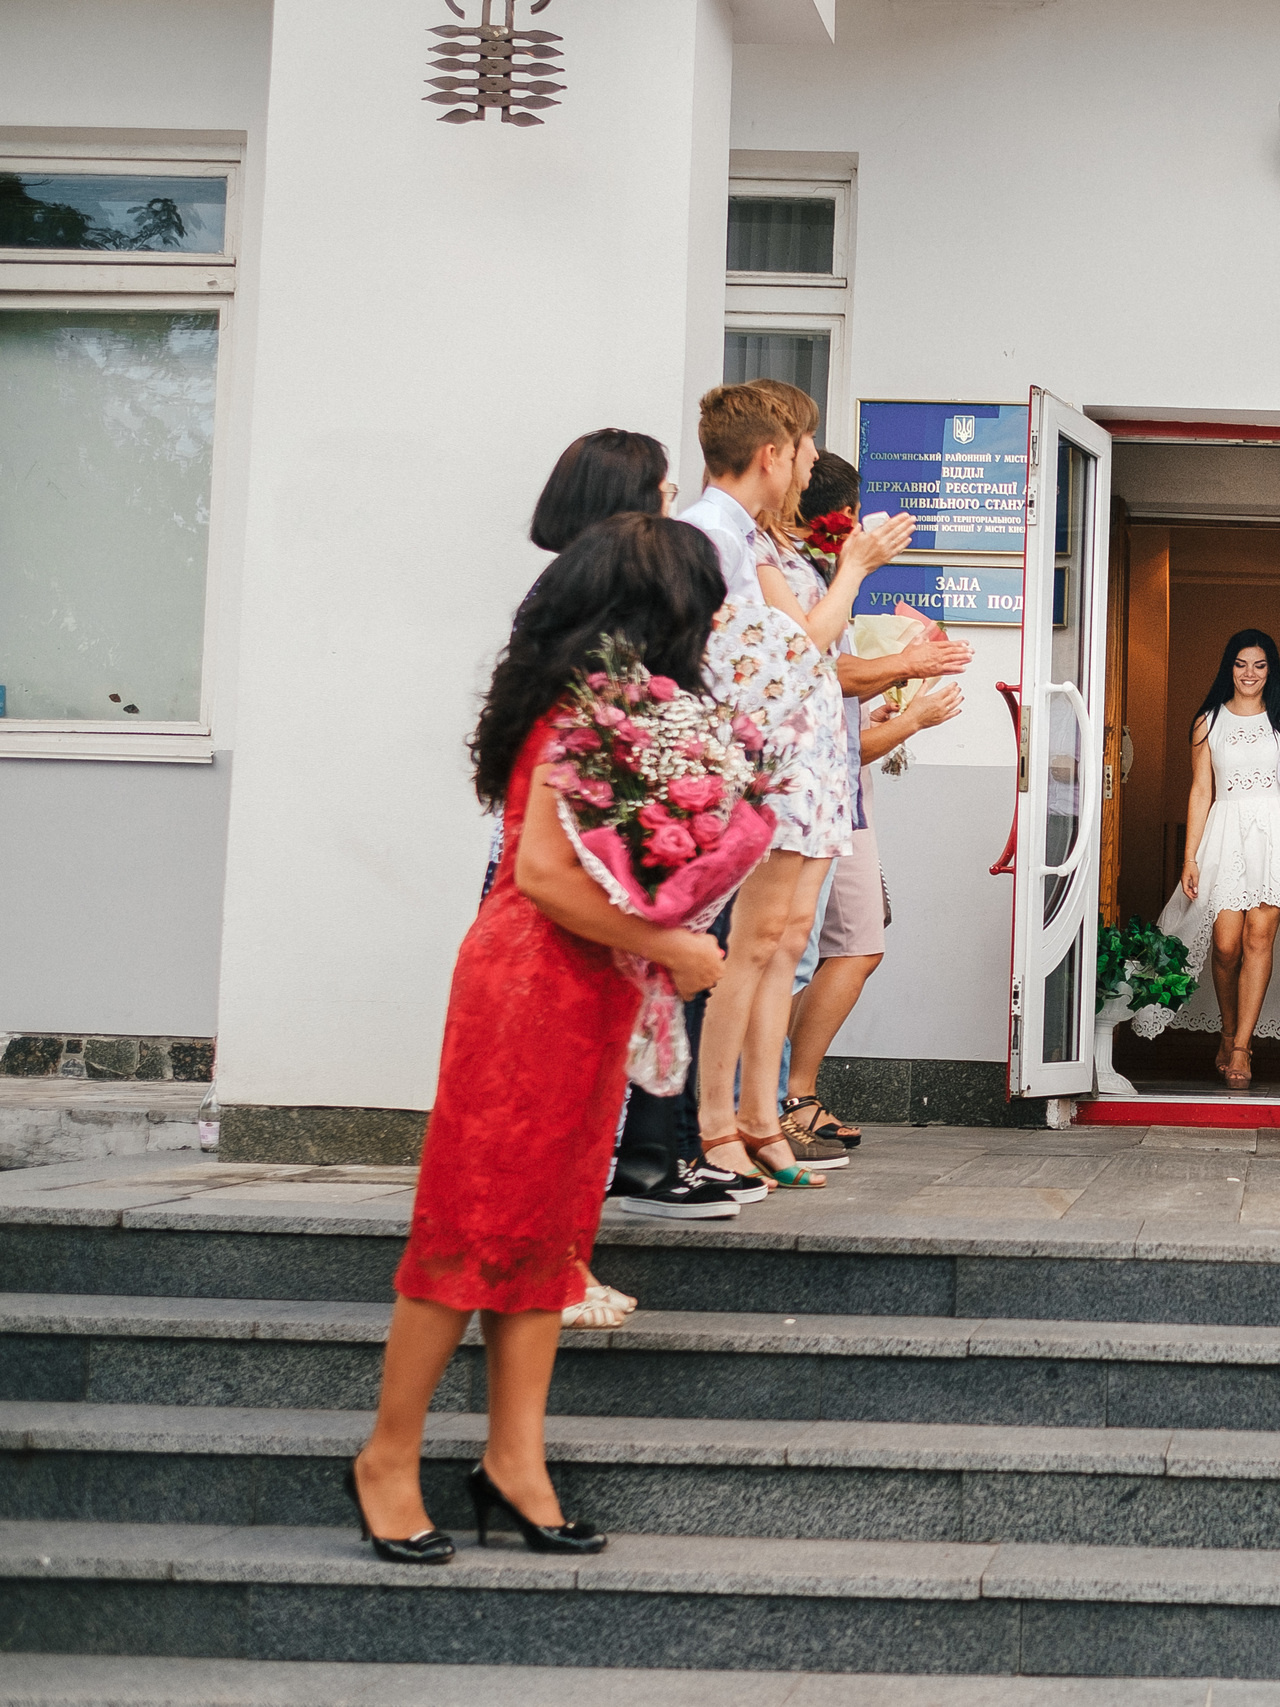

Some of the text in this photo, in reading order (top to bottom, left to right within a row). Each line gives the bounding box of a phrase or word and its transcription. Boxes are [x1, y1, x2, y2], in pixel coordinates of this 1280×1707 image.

[995, 455, 1001, 463] У
[942, 466, 985, 480] ВІДДІЛ
[866, 480, 941, 494] ДЕРЖАВНОЇ
[945, 482, 1018, 496] РЕЄСТРАЦІЇ
[900, 497, 1026, 511] ЦИВІЛЬНОГО СТАНУ
[916, 515, 950, 523] ЛОВНОГО
[976, 525, 982, 533] У
[1008, 526, 1026, 534] КИЄ
[935, 576, 982, 592] ЗАЛА
[870, 592, 1024, 612] УРОЧИСТИХ ПОД
